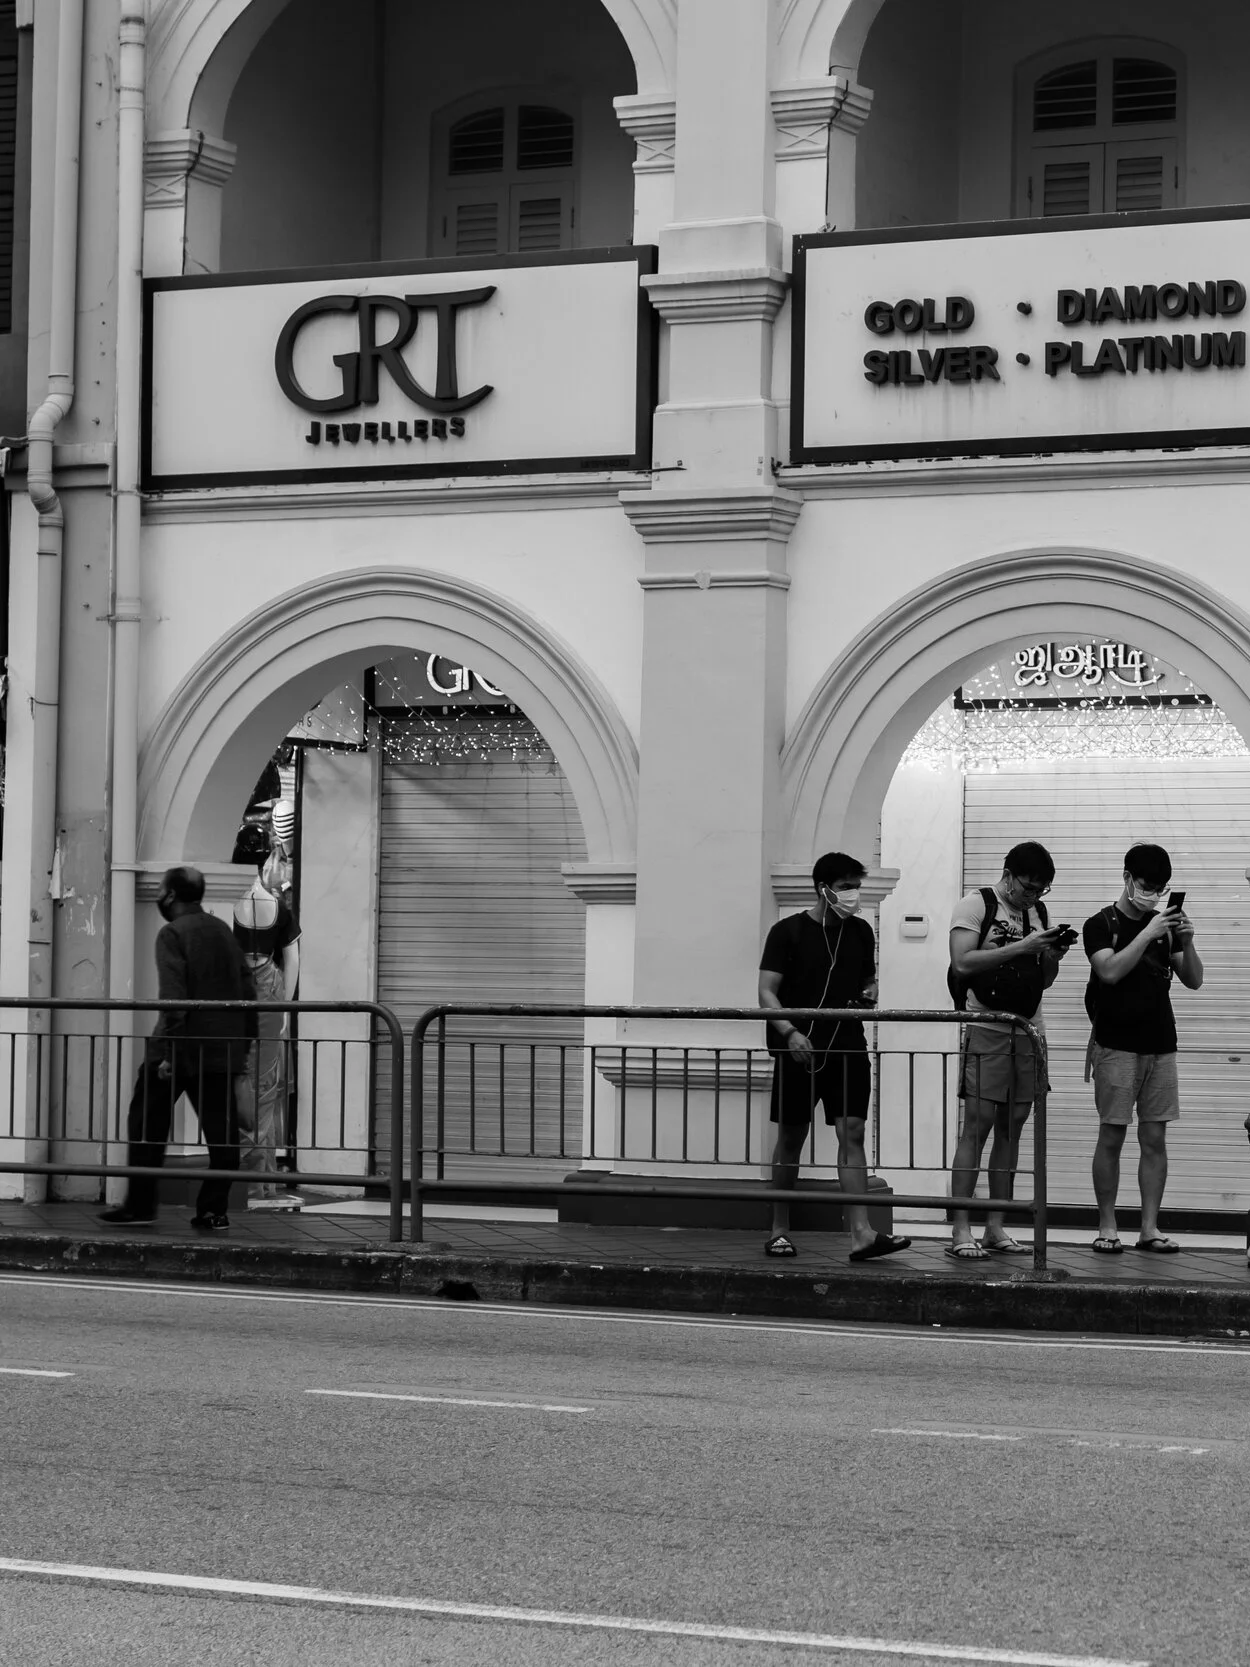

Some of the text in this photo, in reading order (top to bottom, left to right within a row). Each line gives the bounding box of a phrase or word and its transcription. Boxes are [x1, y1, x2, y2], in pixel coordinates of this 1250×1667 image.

[864, 279, 1247, 334] GOLD DIAMOND
[275, 285, 497, 412] GRT
[863, 331, 1246, 384] SILVER PLATINUM
[306, 417, 466, 446] JEWELLERS
